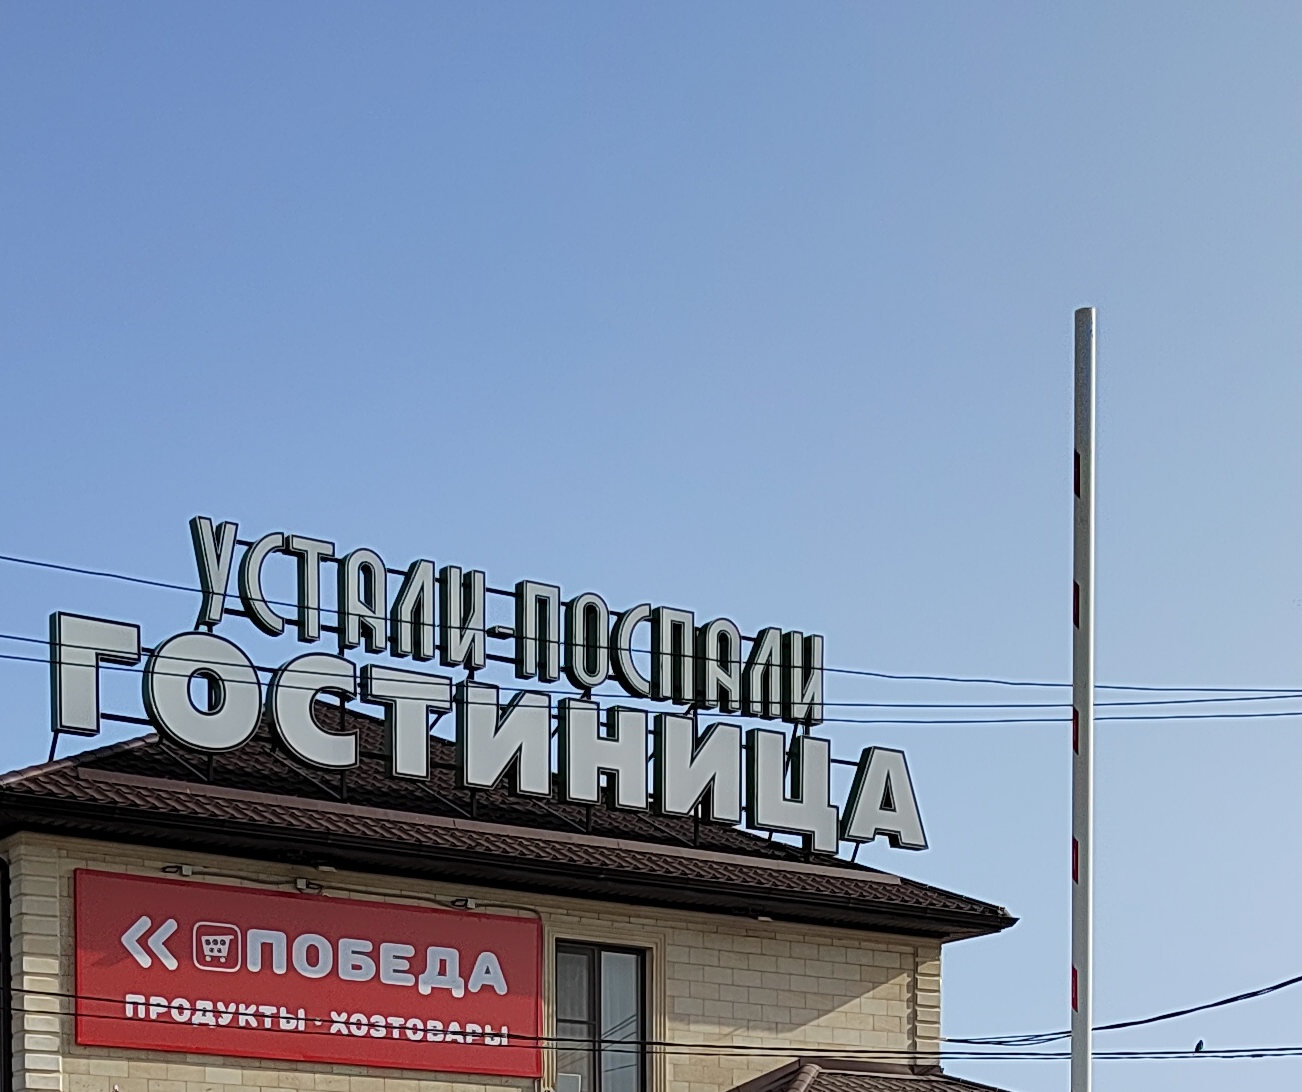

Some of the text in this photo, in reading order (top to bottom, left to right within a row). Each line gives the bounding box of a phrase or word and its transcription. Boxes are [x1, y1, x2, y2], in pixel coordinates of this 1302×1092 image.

[190, 515, 824, 727] УСТАЛИ-ПОСПАЛИ
[50, 610, 929, 854] ГОСТИНИЦА
[124, 994, 510, 1046] ПРОДУКТЫ ХОЗТОВАРЫ
[246, 928, 508, 998] ПОБЕДА
